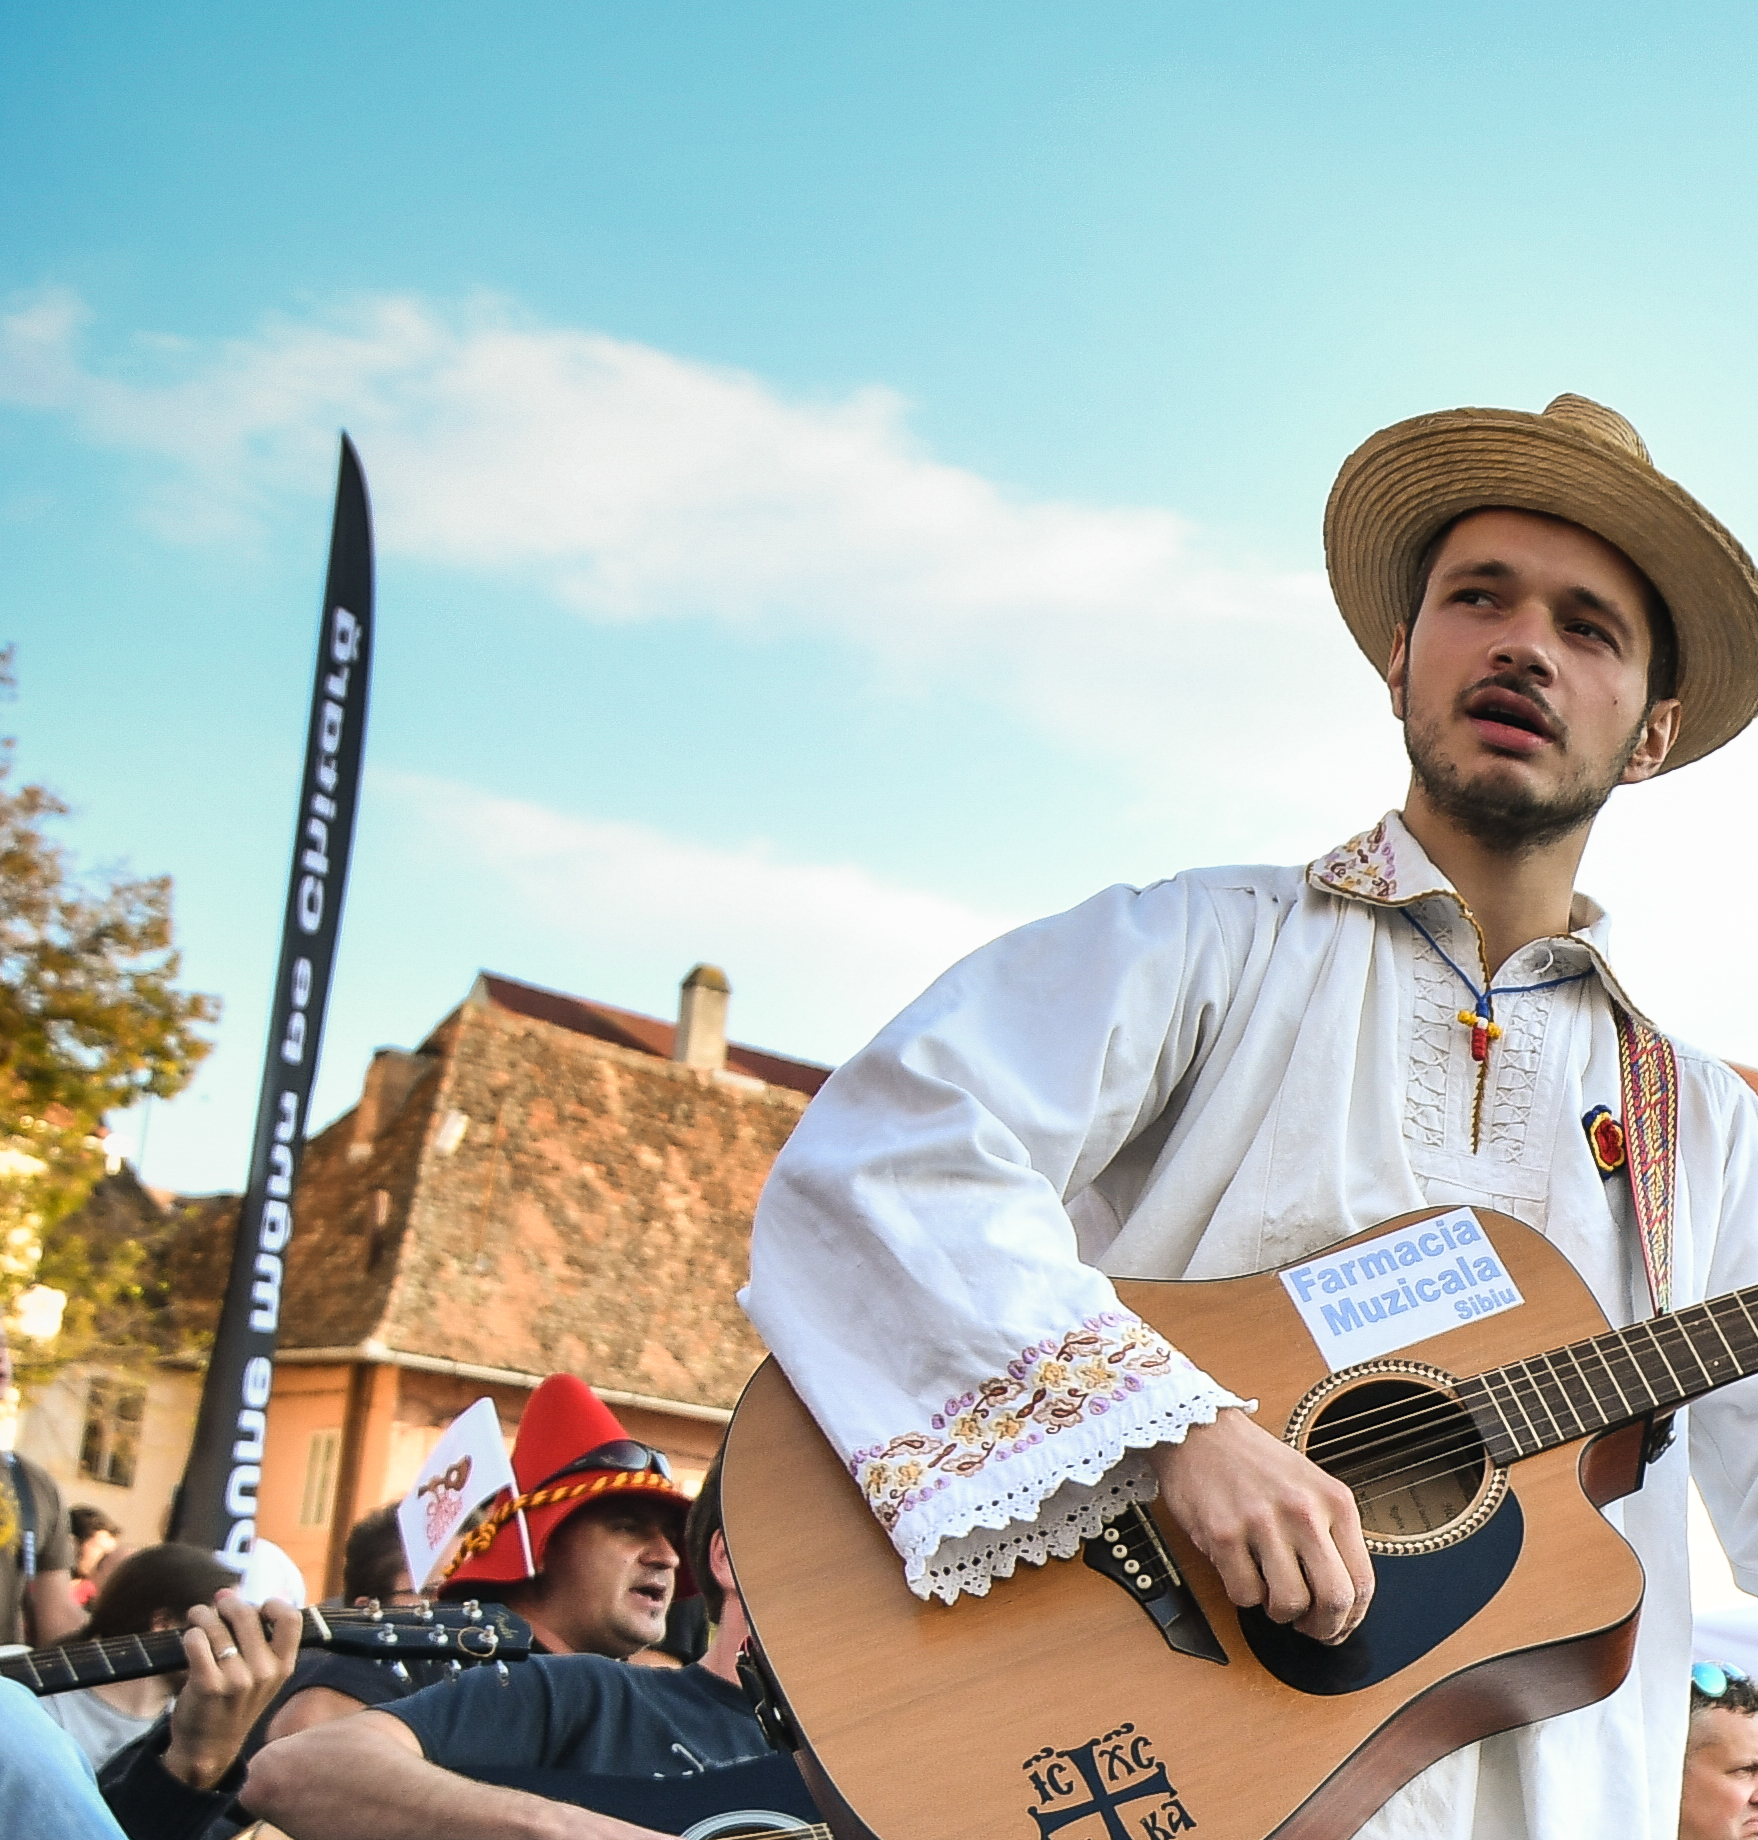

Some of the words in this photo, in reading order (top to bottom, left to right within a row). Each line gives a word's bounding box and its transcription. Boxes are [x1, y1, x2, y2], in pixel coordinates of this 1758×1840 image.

[1289, 1218, 1481, 1303] Farmacia
[1320, 1252, 1502, 1336] Muzicala
[1453, 1285, 1517, 1320] Sibiu
